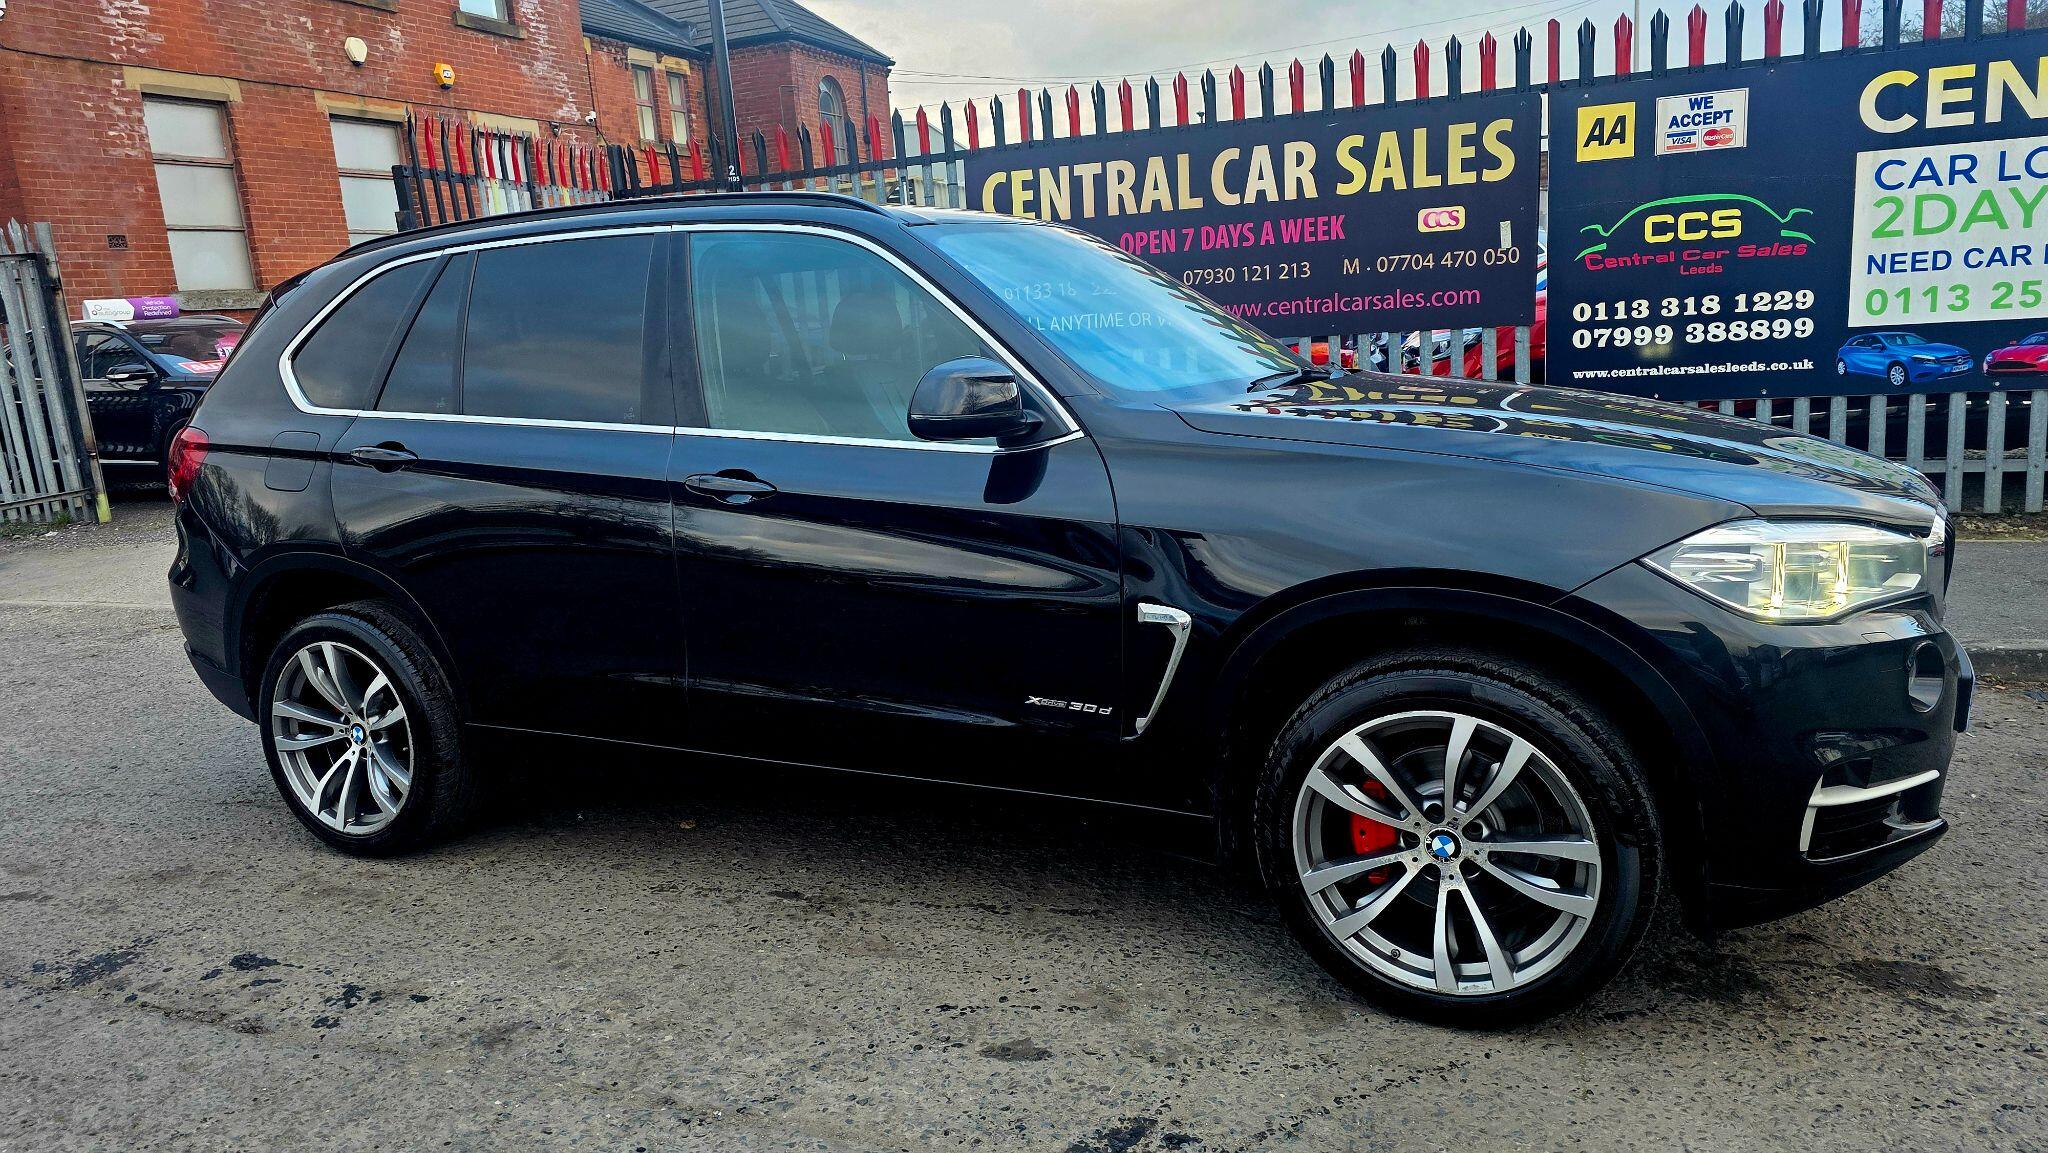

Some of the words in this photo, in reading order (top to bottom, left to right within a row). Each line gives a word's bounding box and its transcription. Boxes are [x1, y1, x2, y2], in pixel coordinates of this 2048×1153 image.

[1688, 95, 1714, 111] WE
[1859, 56, 2048, 134] CEN
[1583, 114, 1627, 148] AA
[1668, 109, 1733, 129] ACCEPT
[1671, 136, 1692, 145] VISA
[982, 153, 1204, 222] CENTRAL
[1210, 141, 1318, 206] CAR
[1335, 118, 1516, 196] SALES
[1874, 153, 1978, 191] CAR
[1422, 209, 1461, 229] CCS
[1644, 208, 1742, 244] CCS
[1871, 184, 2048, 239] 2DAY
[1119, 228, 1176, 256] OPEN
[1181, 228, 1195, 252] 7
[1200, 222, 1254, 250] DAYS
[1260, 220, 1275, 246] A
[1280, 214, 1346, 243] WEEK
[1376, 252, 1435, 273] 07704
[1440, 249, 1477, 268] 470
[1483, 246, 1520, 265] 050
[1584, 250, 1675, 272] Central
[1682, 248, 1730, 261] Car
[1737, 242, 1808, 258] Sales
[1680, 263, 1723, 276] Leeds
[1867, 249, 1953, 275] NEED
[1963, 244, 2033, 270] CAR
[1183, 267, 1235, 286] 07930
[1242, 264, 1271, 282] 121
[1278, 261, 1311, 280] 213
[1572, 299, 1650, 322] 0113
[1661, 294, 1721, 317] 318
[1734, 289, 1815, 313] 1229
[1865, 283, 1970, 316] 0113
[1990, 279, 2043, 310] 25
[1050, 311, 1124, 332] ANYTIME
[1128, 311, 1152, 327] OR
[1572, 324, 1674, 349] 07999
[1685, 317, 1814, 344] 388899
[1573, 358, 1814, 379] www.centralcarsalesleeds.co.uk
